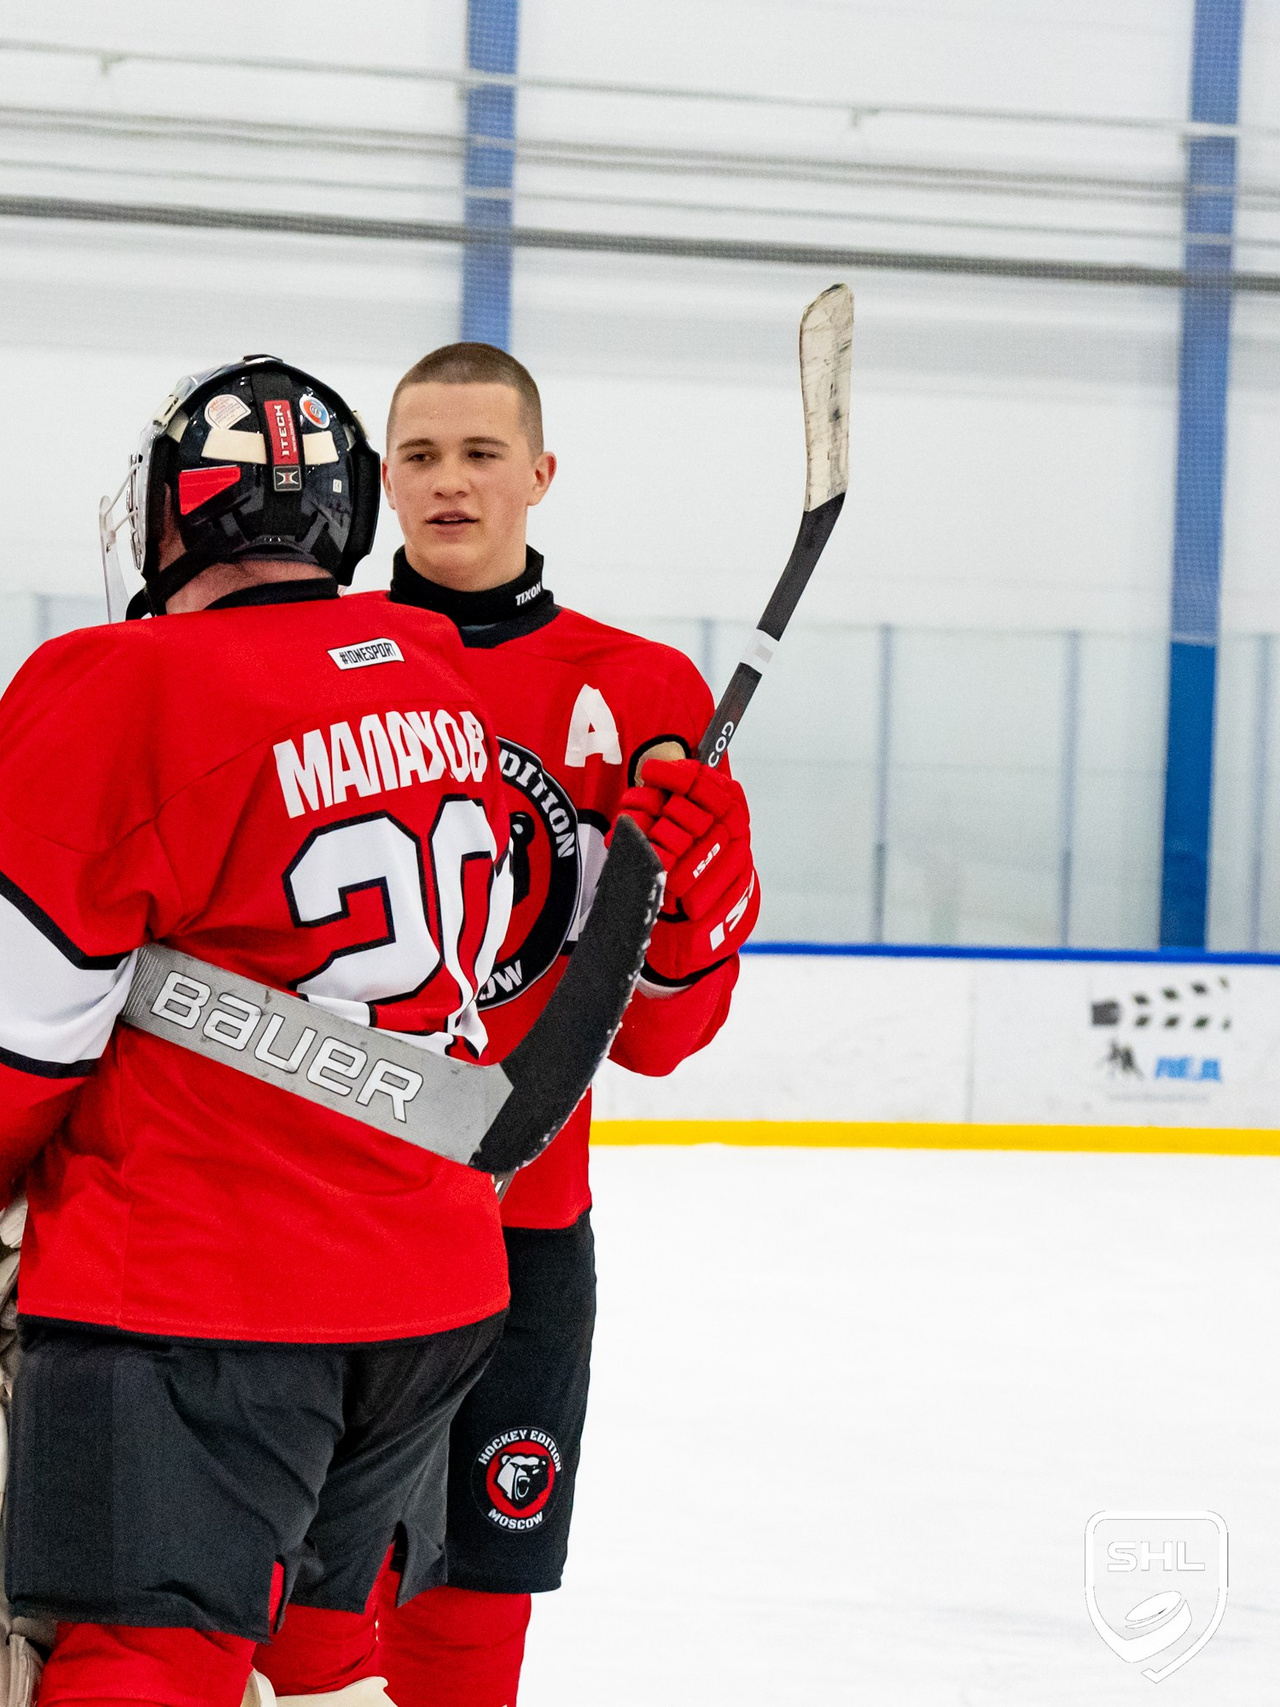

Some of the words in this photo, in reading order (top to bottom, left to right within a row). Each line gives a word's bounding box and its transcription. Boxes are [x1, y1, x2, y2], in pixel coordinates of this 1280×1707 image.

[273, 404, 291, 457] ITECH
[515, 581, 542, 606] TIXON
[564, 683, 622, 767] A
[498, 748, 576, 858] DITION
[692, 842, 721, 879] EFSI
[282, 794, 515, 1062] 20
[478, 1429, 528, 1465] HOCKEY
[530, 1430, 562, 1472] EDITION
[488, 1508, 543, 1530] MOSCOW
